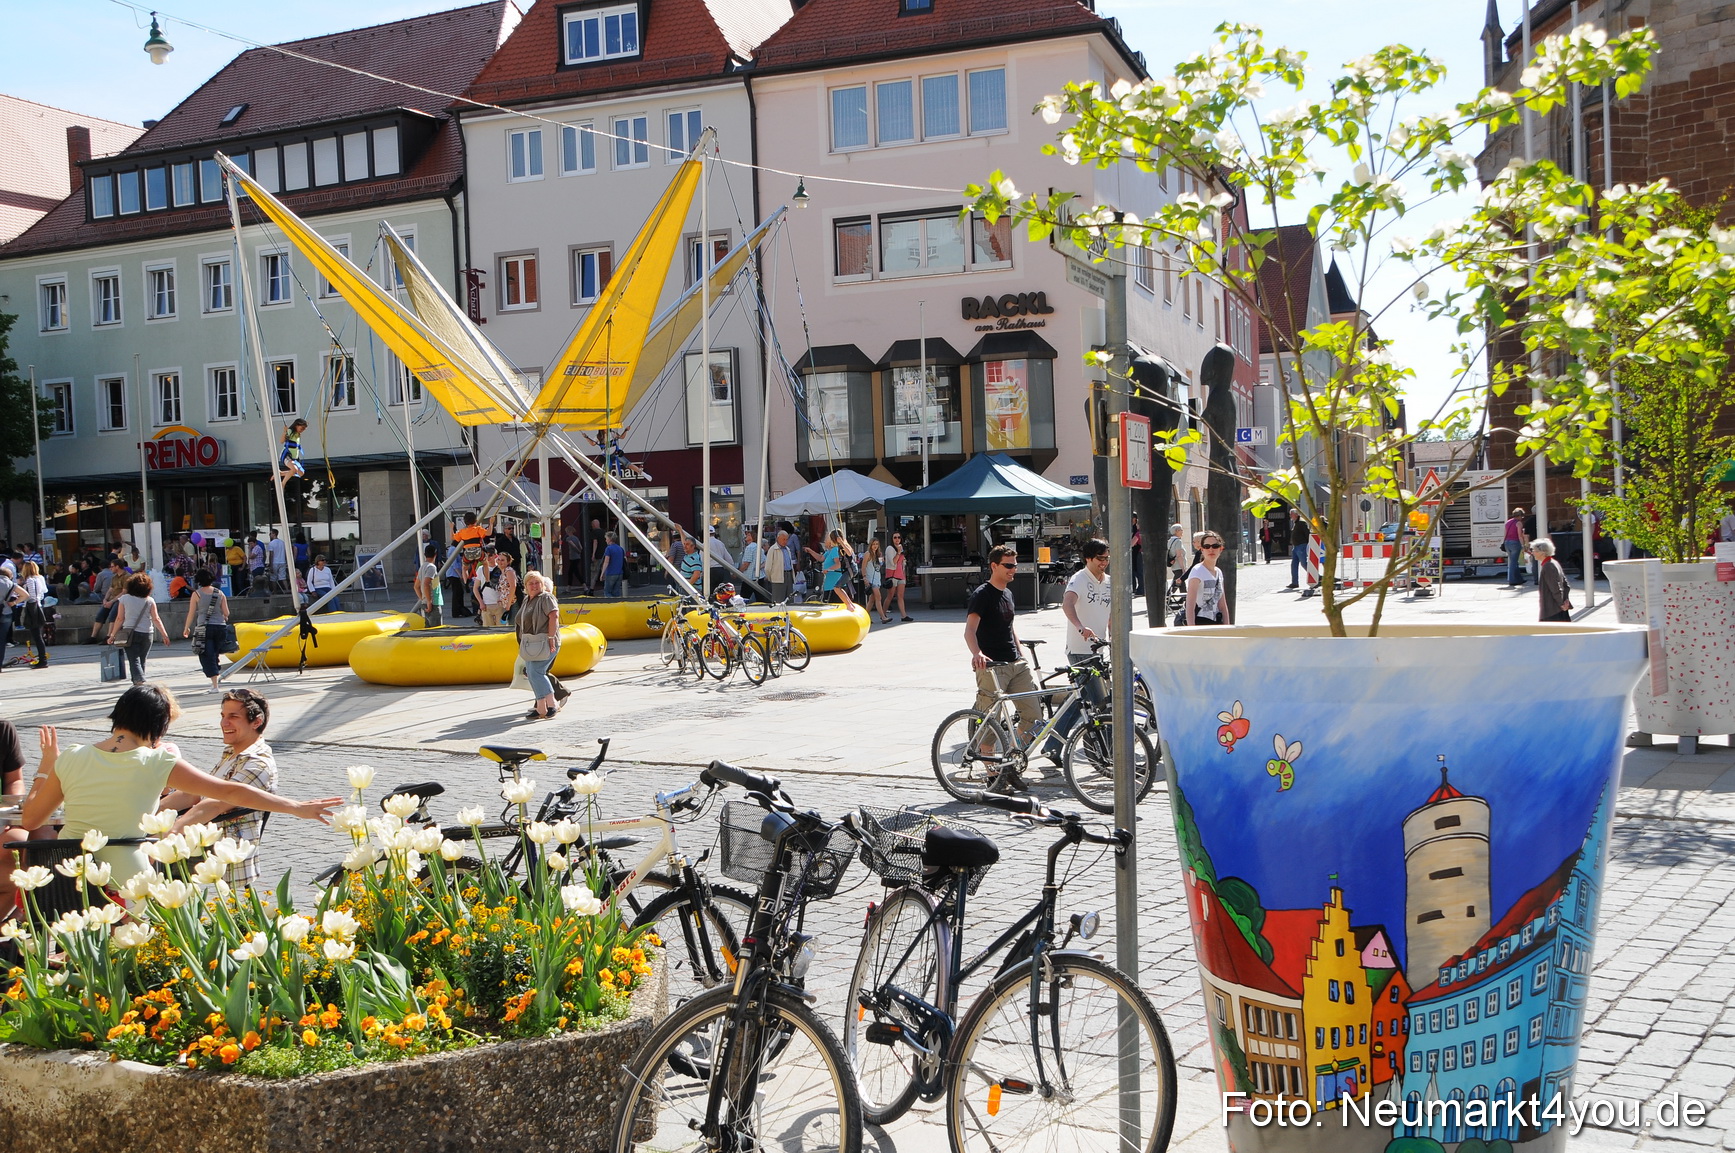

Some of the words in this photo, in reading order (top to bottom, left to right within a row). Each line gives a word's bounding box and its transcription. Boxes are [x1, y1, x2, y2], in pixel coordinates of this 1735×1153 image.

[961, 291, 1055, 321] RACKL
[974, 324, 994, 332] am
[996, 317, 1046, 331] Rathaus
[136, 434, 220, 471] RENO
